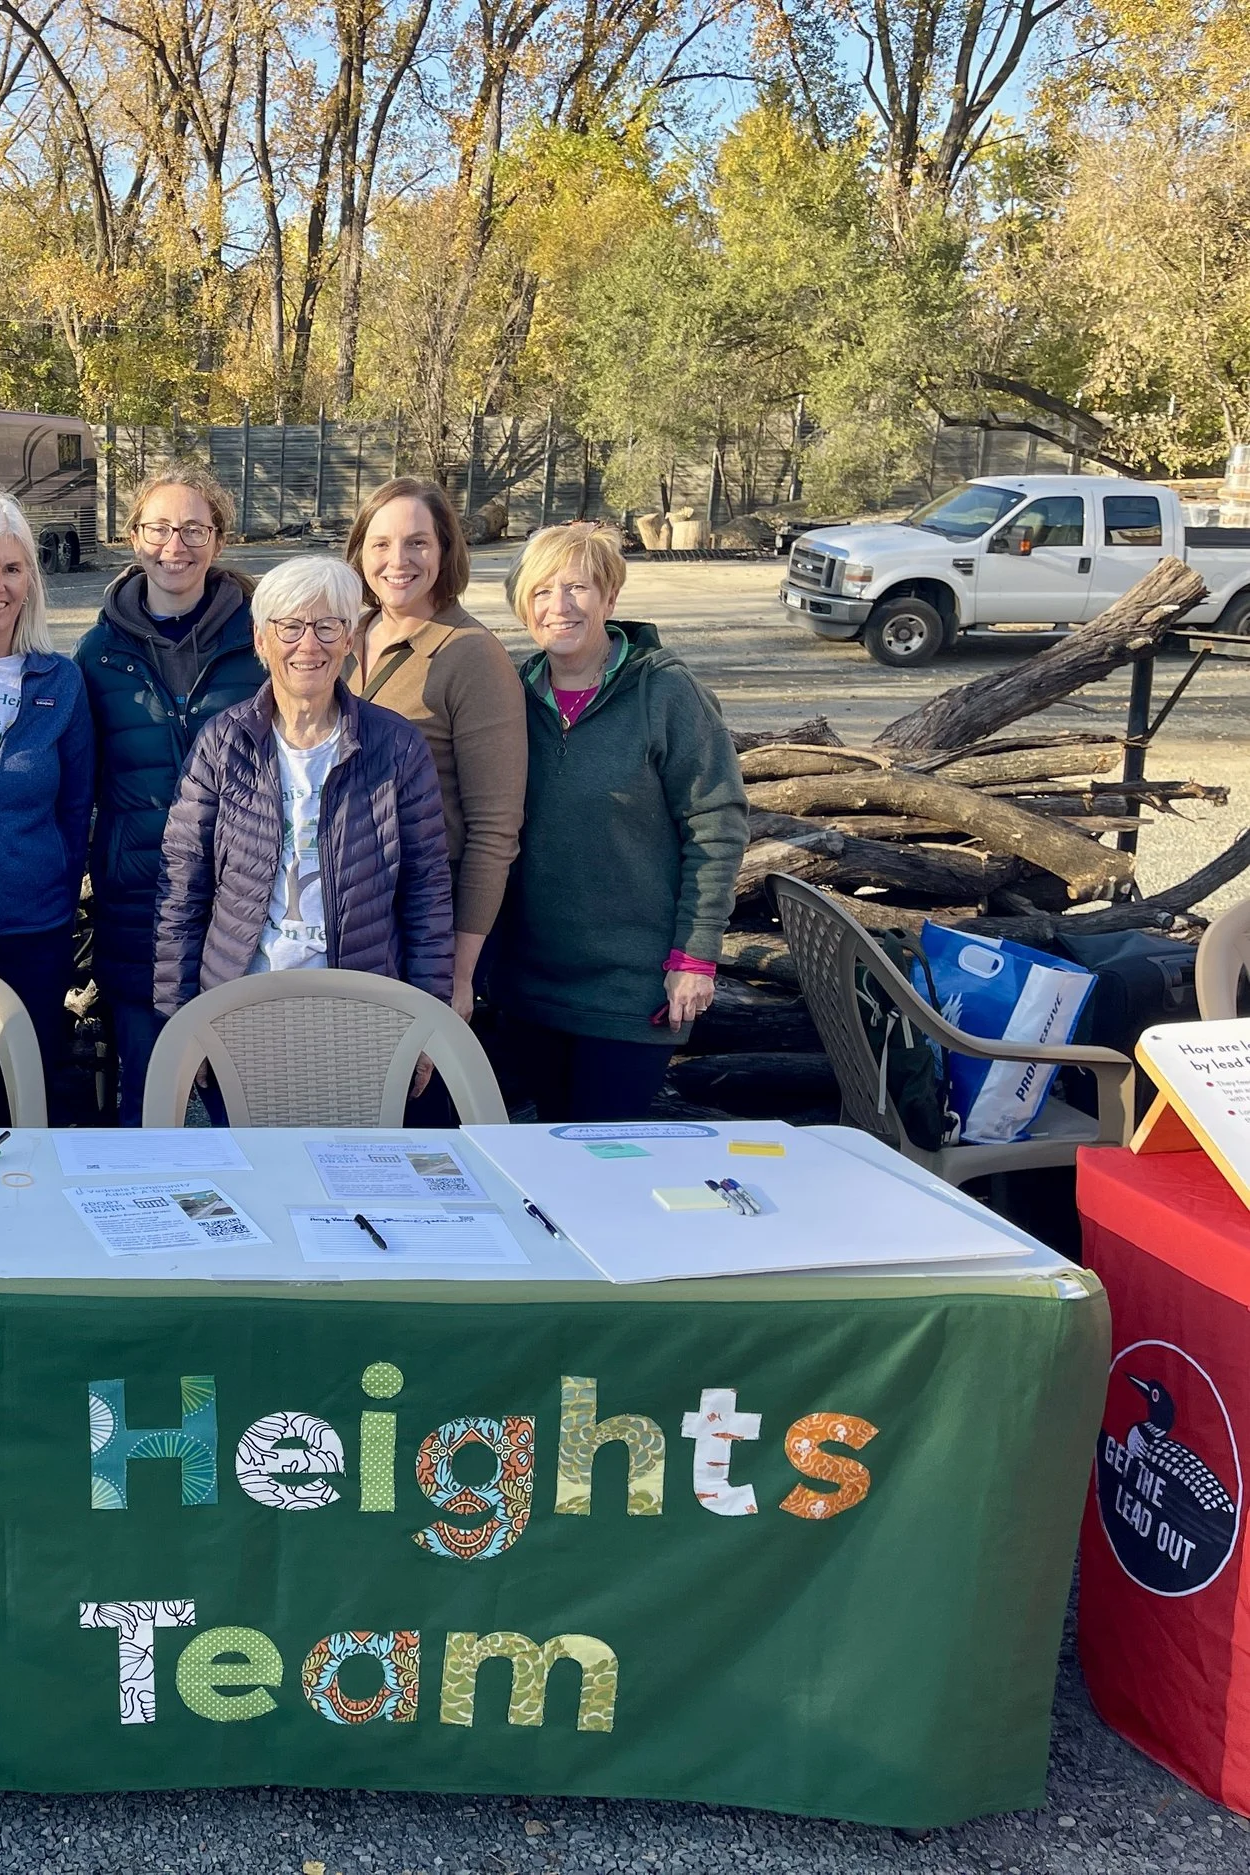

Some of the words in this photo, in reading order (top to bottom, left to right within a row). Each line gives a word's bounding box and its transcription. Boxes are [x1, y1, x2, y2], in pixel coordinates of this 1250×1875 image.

[1178, 1043, 1214, 1055] How
[1217, 1044, 1240, 1053] are
[1190, 1060, 1211, 1074] by
[1211, 1057, 1244, 1070] lead
[88, 1361, 880, 1560] Heights
[1105, 1435, 1134, 1479] GET
[1134, 1460, 1167, 1509] THE
[1115, 1484, 1152, 1538] LEAD
[1156, 1521, 1196, 1570] OUT
[79, 1598, 620, 1733] Team
